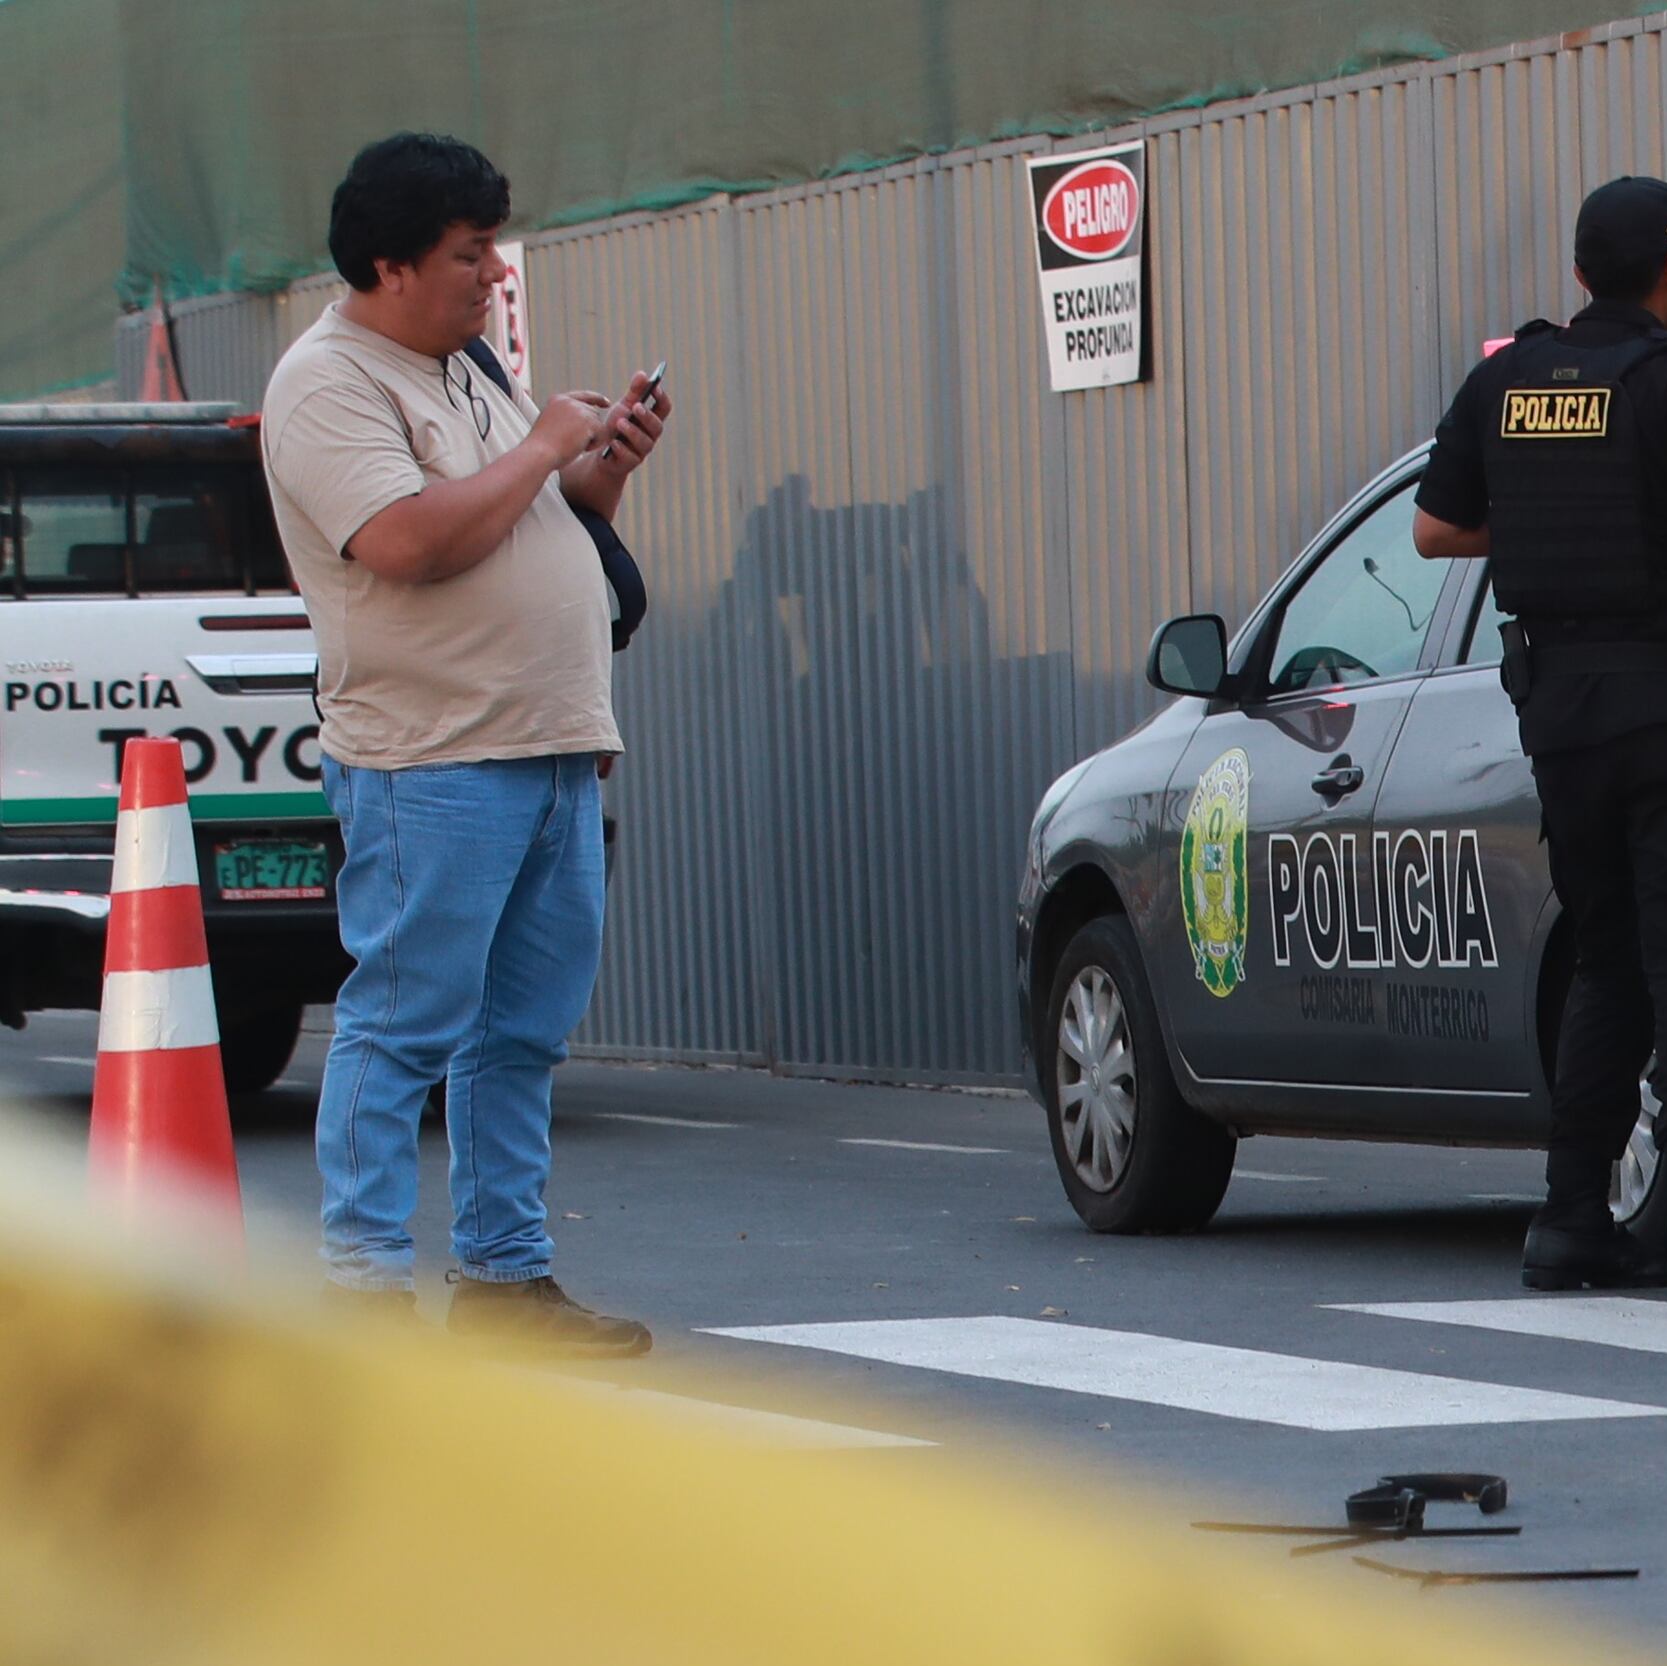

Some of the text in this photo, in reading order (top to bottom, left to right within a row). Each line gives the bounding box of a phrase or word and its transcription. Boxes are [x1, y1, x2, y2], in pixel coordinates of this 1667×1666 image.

[1062, 181, 1129, 240] PELIGRO
[1053, 279, 1137, 323] EXCAVACION
[1065, 321, 1134, 362] PROFUNDA
[1507, 395, 1601, 431] POLICIA
[5, 672, 183, 712] POLICÍA
[97, 725, 322, 784] TOYO
[1268, 828, 1500, 971] POLICIA
[1386, 982, 1490, 1043] MONTERRICO
